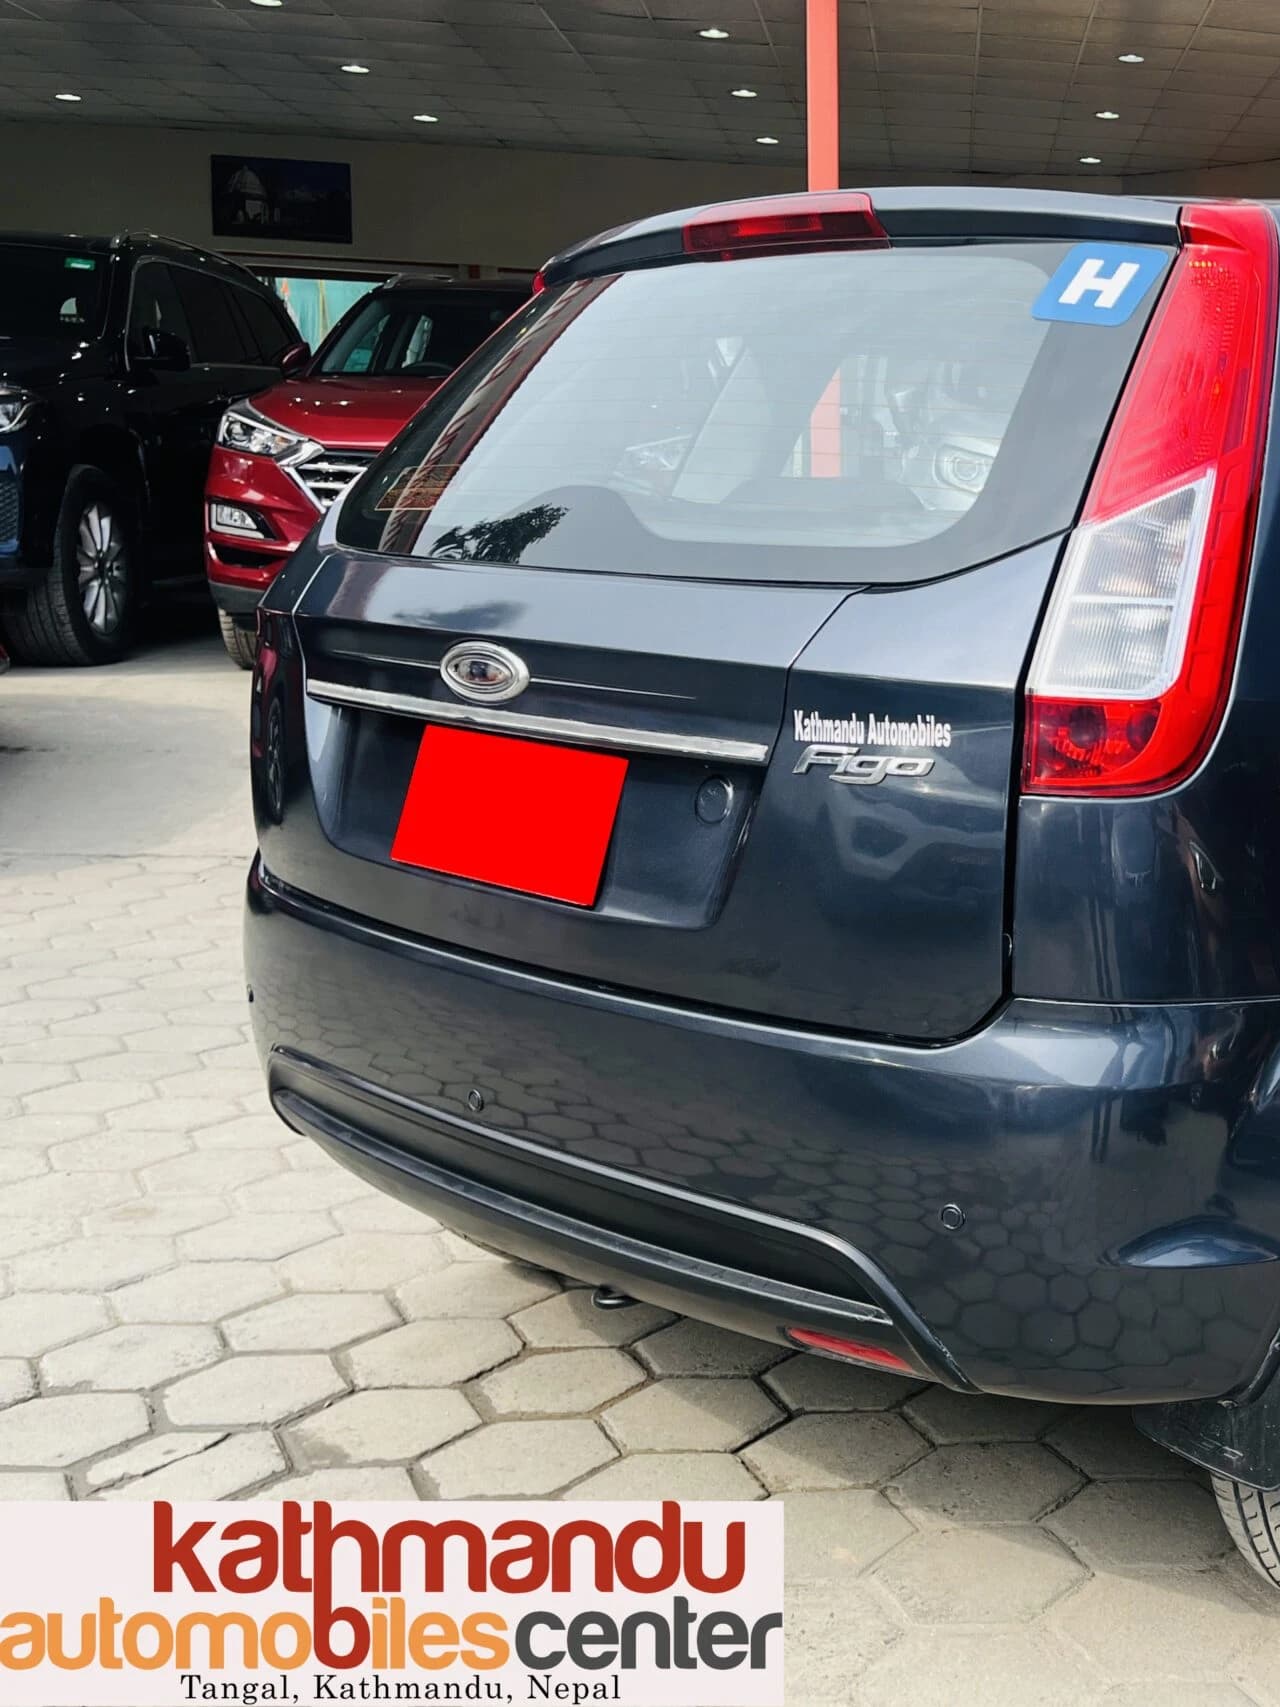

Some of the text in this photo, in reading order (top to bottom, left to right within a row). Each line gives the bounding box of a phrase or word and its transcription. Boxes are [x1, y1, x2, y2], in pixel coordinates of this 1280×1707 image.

[1058, 258, 1140, 308] H
[793, 710, 952, 748] Kathmandu Automobiles
[792, 744, 936, 786] Figo
